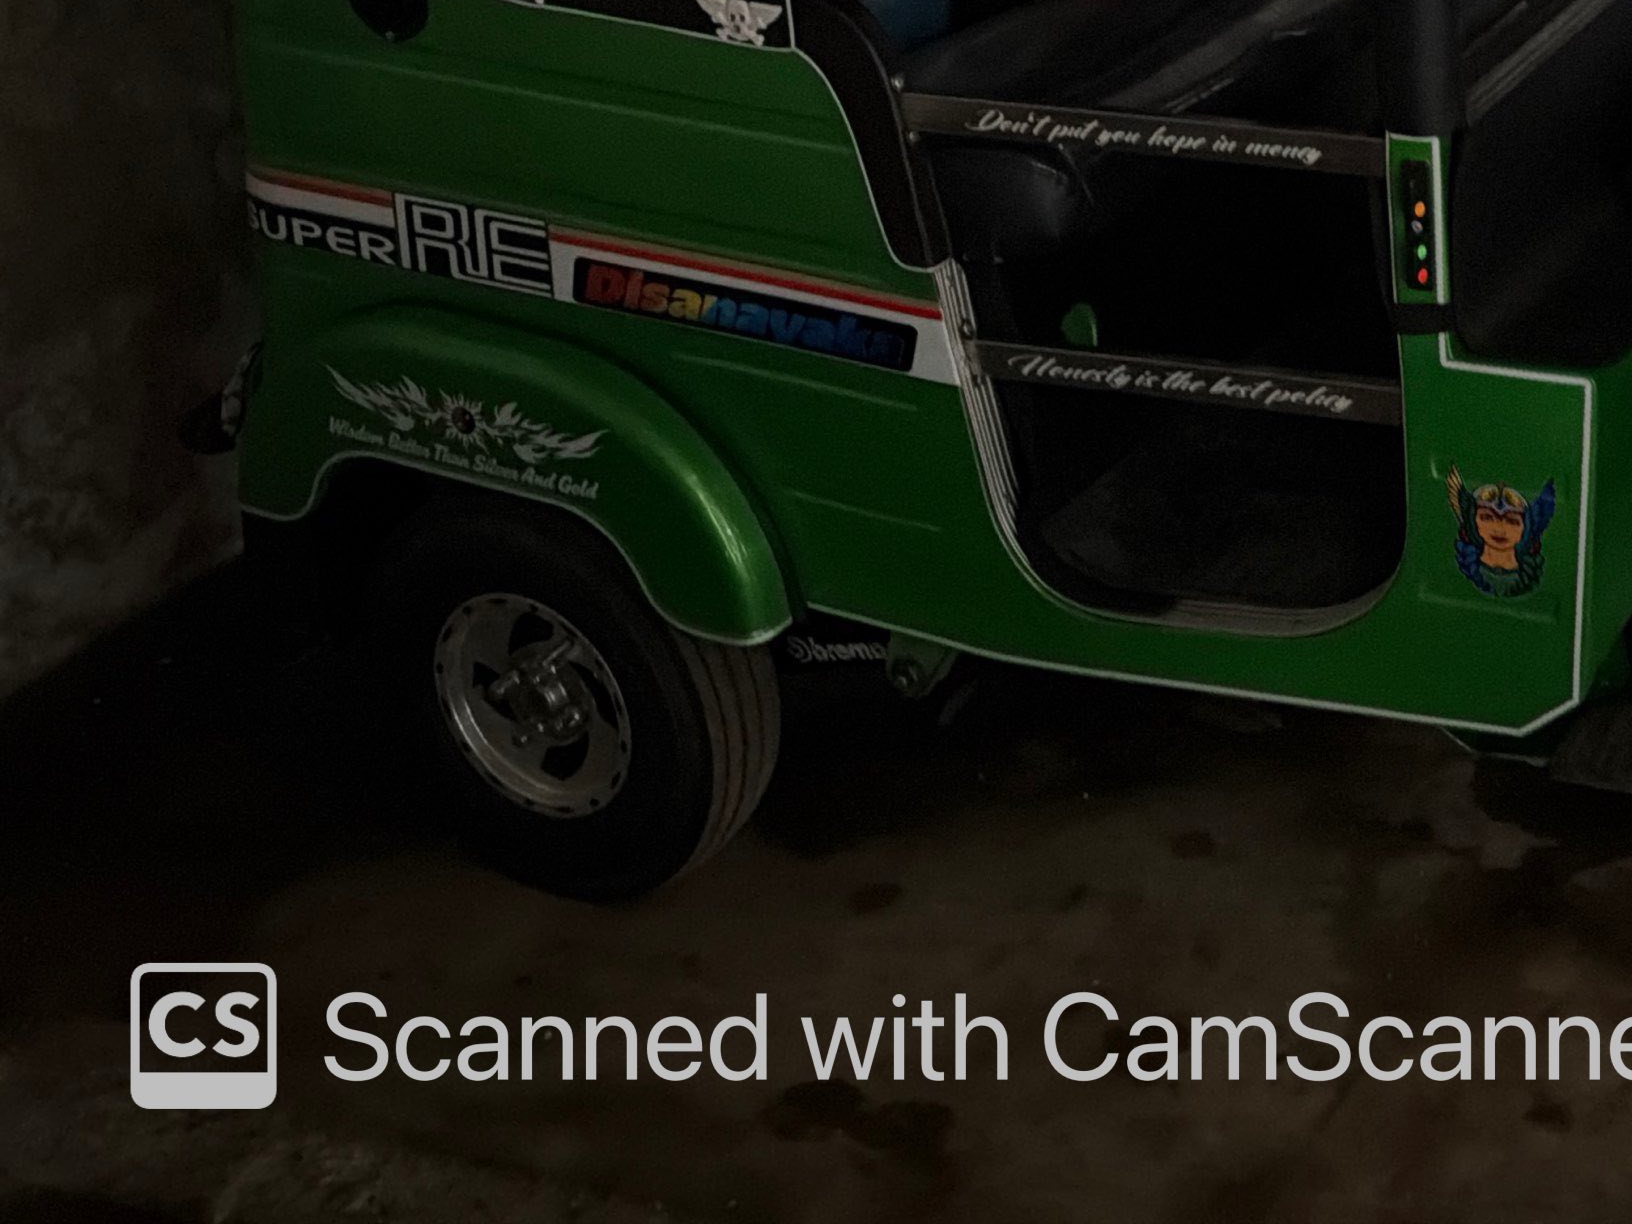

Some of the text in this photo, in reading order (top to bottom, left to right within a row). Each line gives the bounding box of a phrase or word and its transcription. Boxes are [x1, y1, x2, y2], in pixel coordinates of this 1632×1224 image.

[965, 109, 1051, 137] Don't
[1048, 120, 1098, 144] put
[1097, 126, 1141, 147] you
[1147, 126, 1205, 154] hope
[1211, 134, 1237, 153] in
[394, 192, 552, 300] RE
[1133, 370, 1160, 389] is
[1161, 369, 1207, 392] the
[1210, 376, 1271, 401] best
[558, 475, 600, 500] Gold
